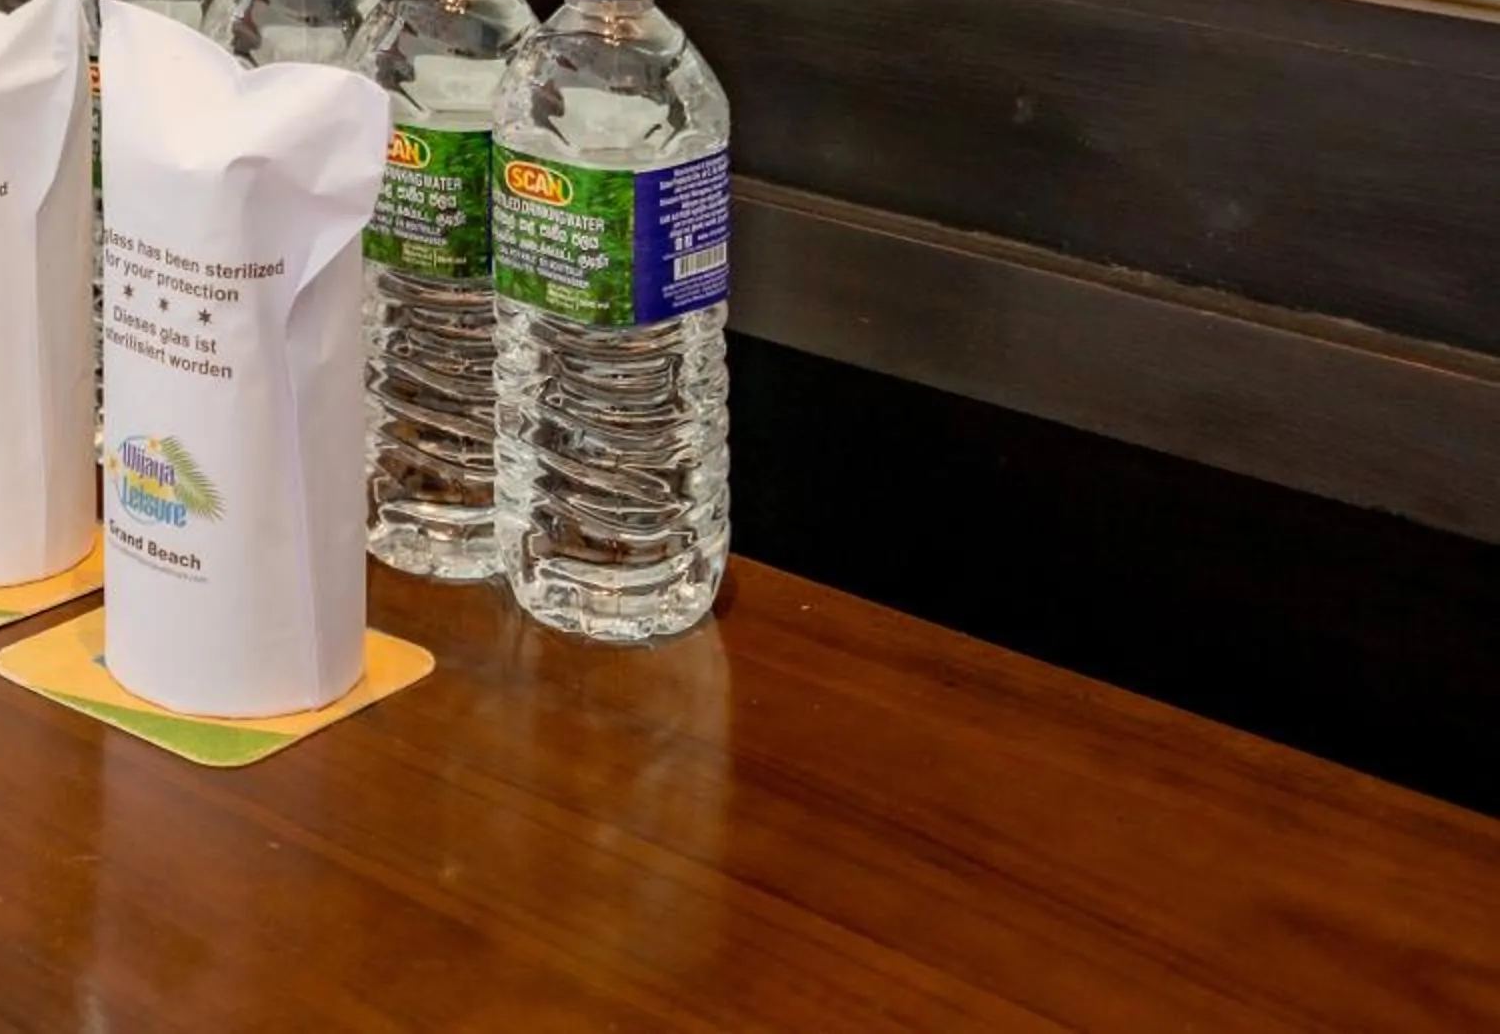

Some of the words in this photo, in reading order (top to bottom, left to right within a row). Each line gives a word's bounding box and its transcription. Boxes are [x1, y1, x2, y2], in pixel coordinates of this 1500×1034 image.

[424, 175, 462, 191] WATER
[511, 167, 563, 199] SCAN
[568, 213, 605, 233] WATER
[137, 238, 161, 260] has
[166, 248, 200, 273] been
[205, 258, 285, 280] sterilized
[123, 259, 155, 281] your
[157, 272, 239, 302] protection
[113, 305, 157, 336] Dieses
[160, 327, 190, 348] glas
[195, 334, 217, 354] ist
[169, 353, 233, 379] worden
[122, 476, 187, 528] Leisure
[109, 519, 143, 550] Grand
[148, 540, 201, 570] Beach
